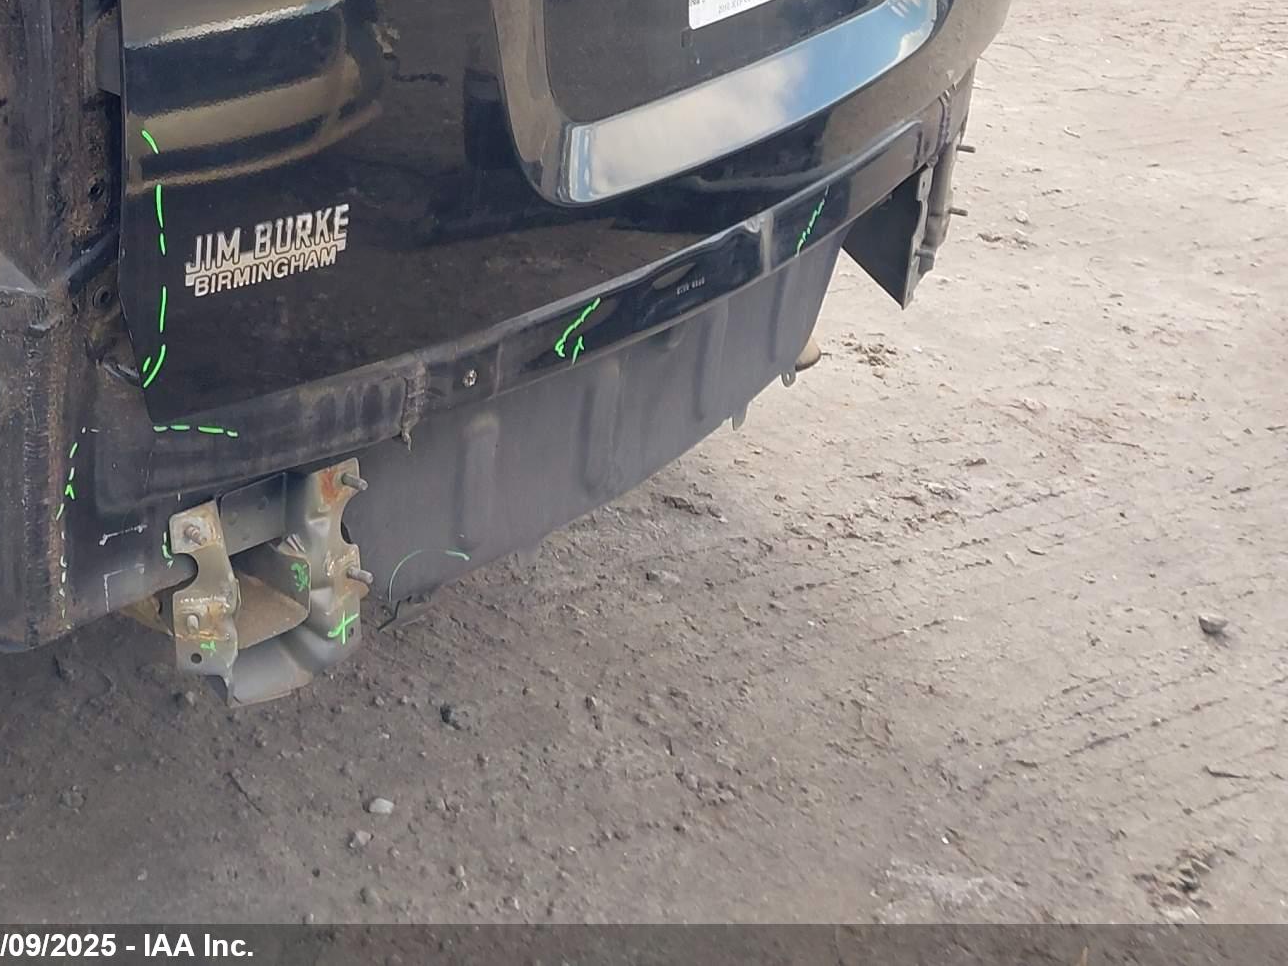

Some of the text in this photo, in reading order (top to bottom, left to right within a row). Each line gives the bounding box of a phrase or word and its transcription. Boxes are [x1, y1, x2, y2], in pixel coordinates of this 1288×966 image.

[185, 203, 350, 274] JIM BURKE
[194, 245, 338, 297] BIRMINGHAM
